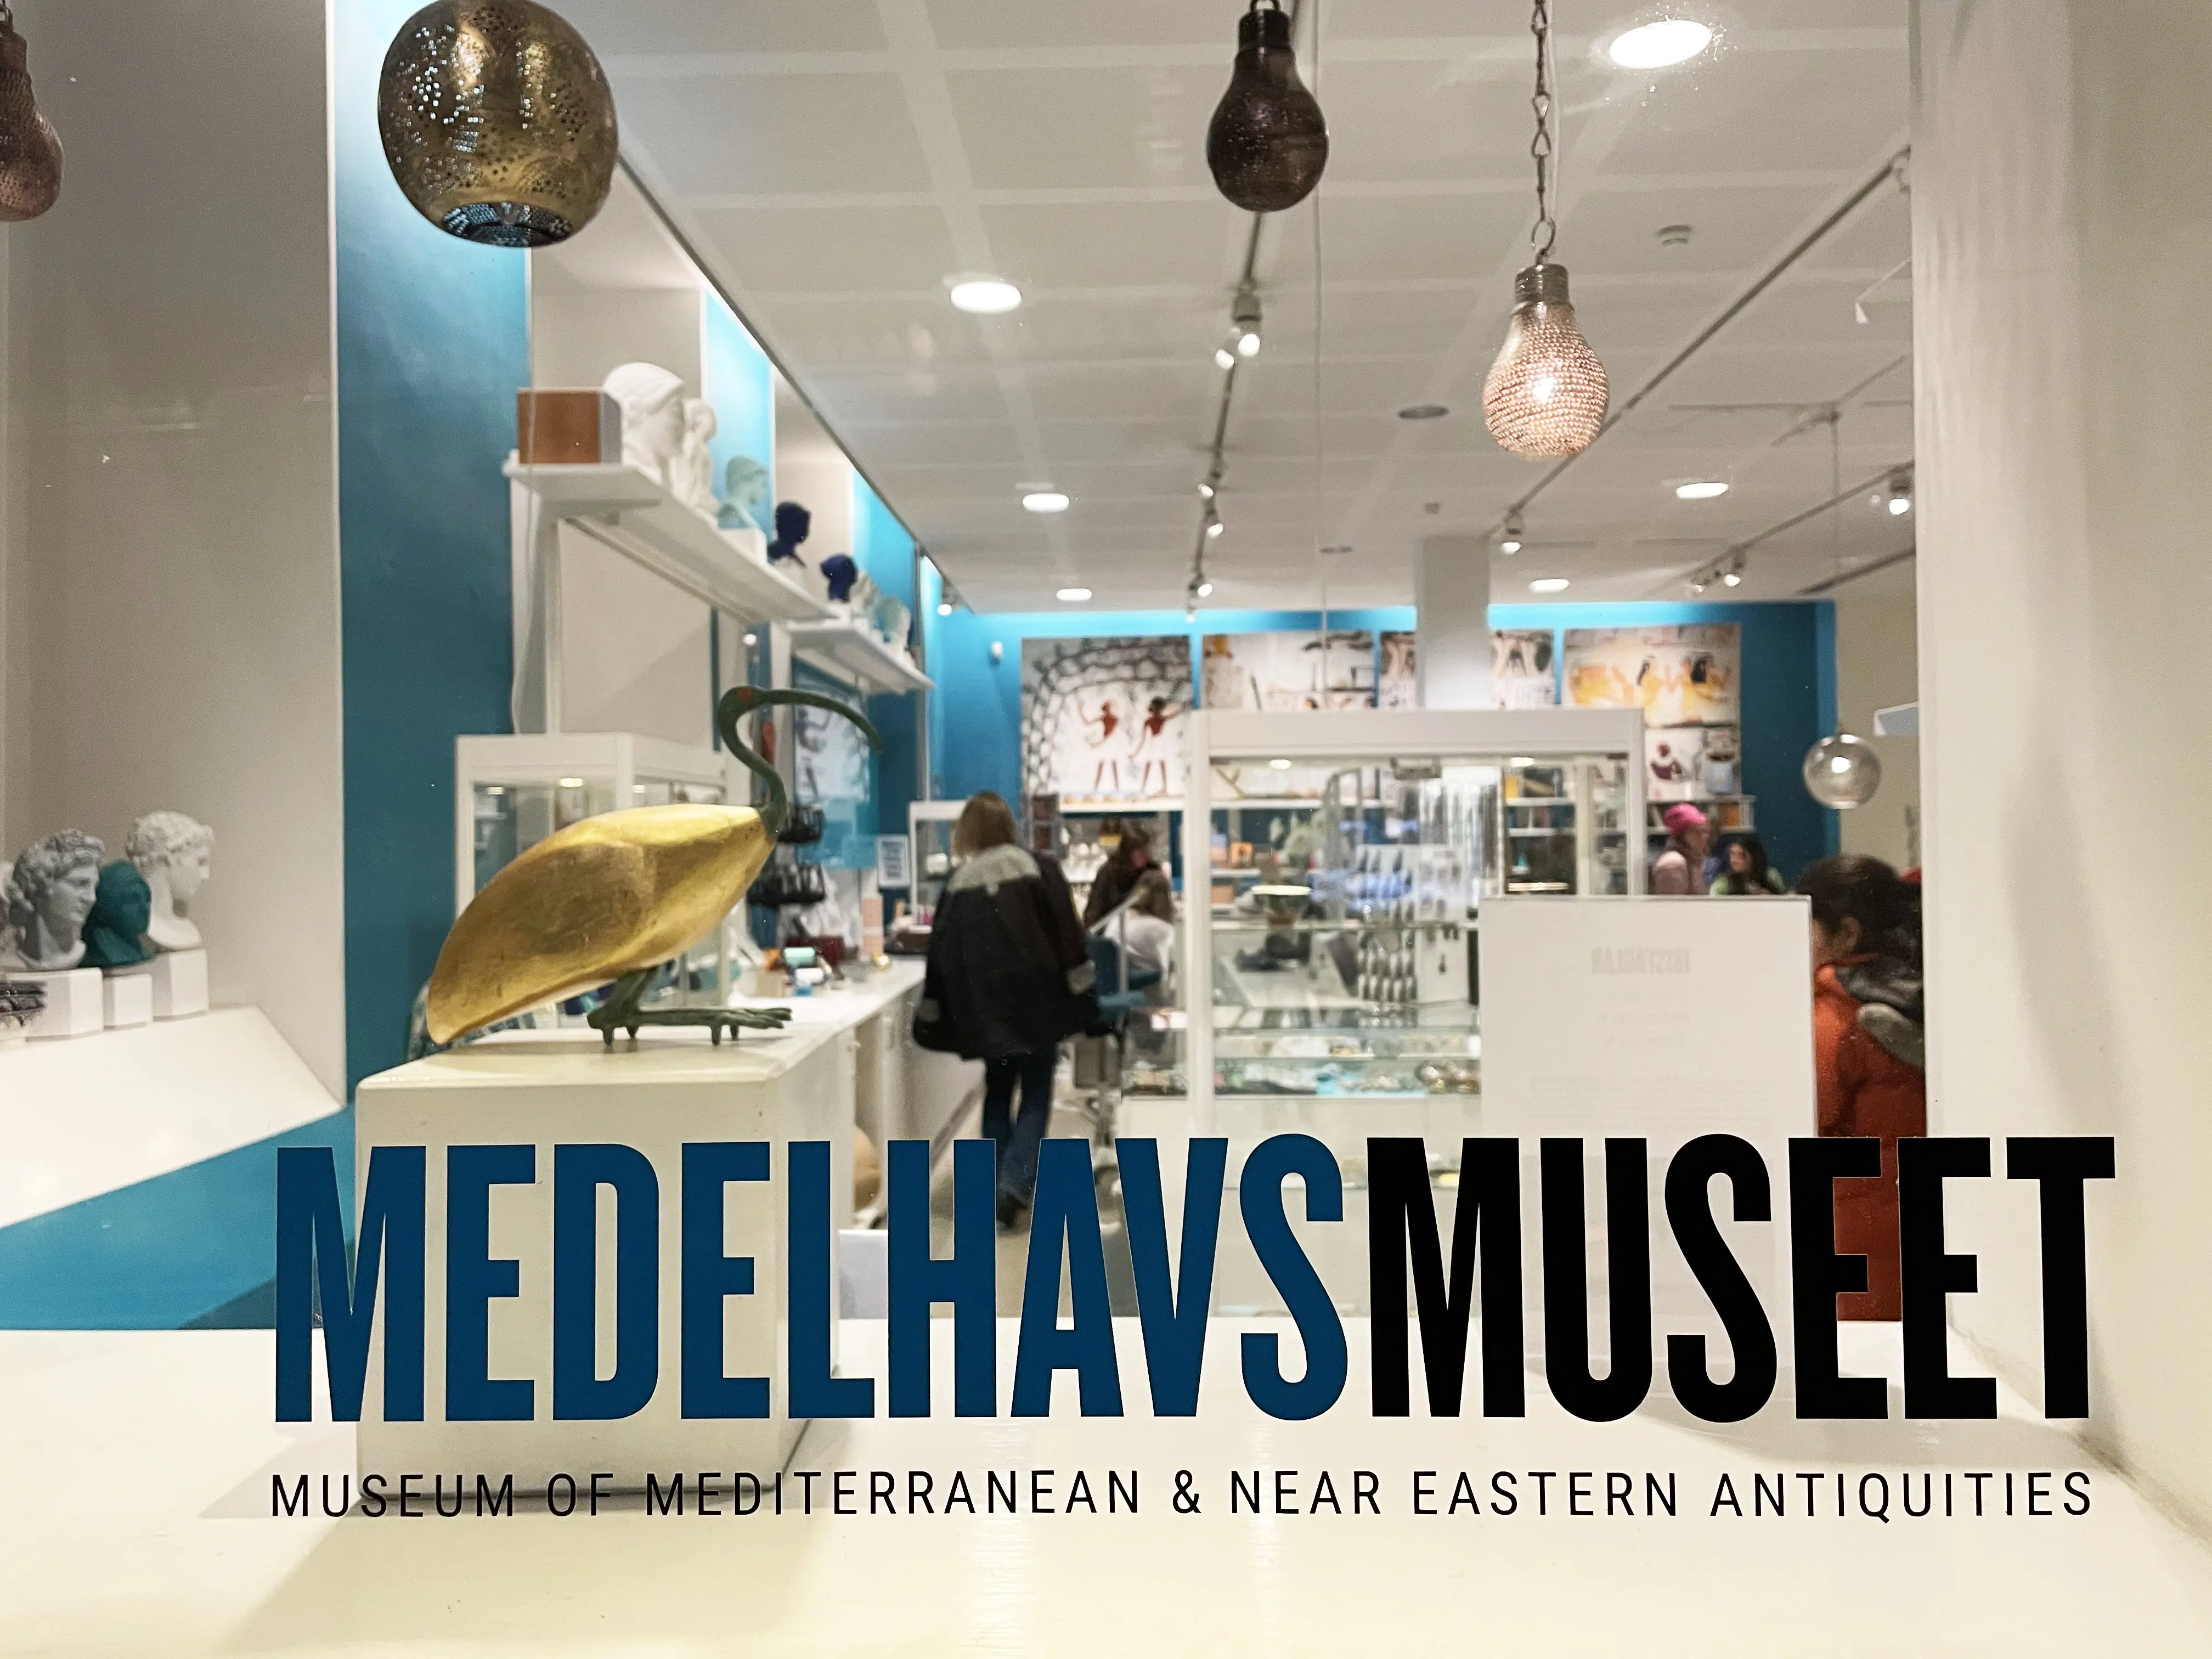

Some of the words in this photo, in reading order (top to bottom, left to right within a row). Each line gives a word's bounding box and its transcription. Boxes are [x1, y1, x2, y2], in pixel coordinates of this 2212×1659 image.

[275, 1134, 2115, 1423] MEDELHAVSMUSEET
[272, 1474, 513, 1517] MUSEUM
[548, 1473, 614, 1516] OF
[646, 1470, 1138, 1516] MEDITERRANEAN
[1172, 1470, 1201, 1514] &
[1231, 1470, 1381, 1514] NEAR
[1413, 1471, 1676, 1516] EASTERN
[1710, 1471, 2090, 1523] ANTIQUITIES
